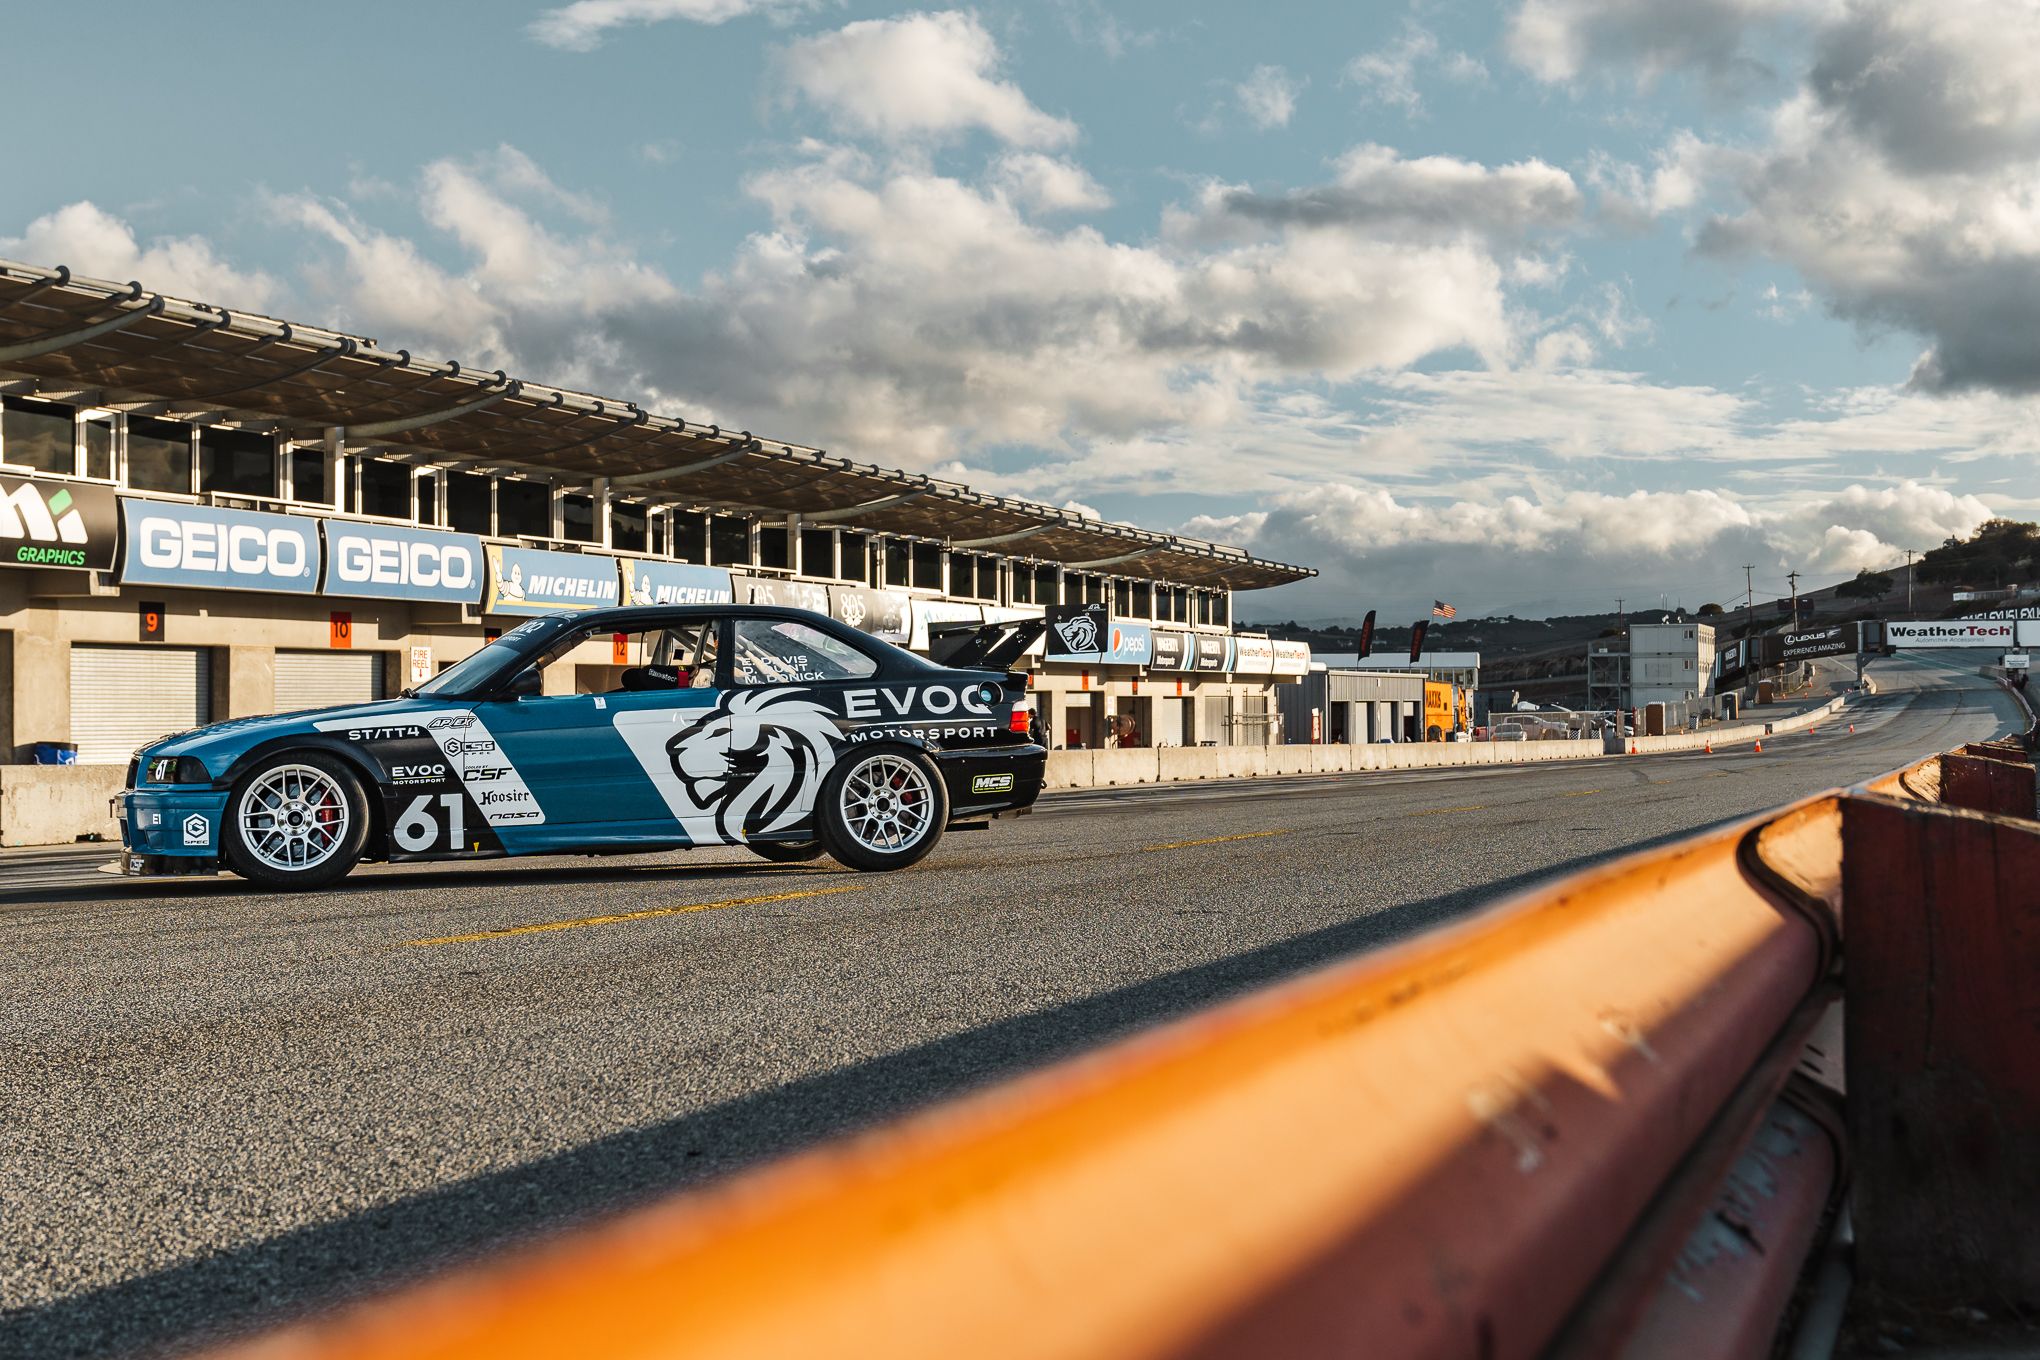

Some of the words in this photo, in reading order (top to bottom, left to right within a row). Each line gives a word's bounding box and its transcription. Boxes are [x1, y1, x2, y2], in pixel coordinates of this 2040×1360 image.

[140, 517, 306, 577] GEICO
[17, 546, 86, 565] GRAPHICS
[338, 536, 472, 589] GEICO
[528, 575, 616, 599] MICHELIN
[656, 585, 730, 603] MICHELIN
[841, 593, 867, 618] 805
[145, 612, 158, 632] 9
[333, 621, 349, 638] 10
[1795, 632, 1826, 642] LEXUS
[1890, 626, 2011, 638] WeatherTech
[615, 641, 625, 656] 12
[1123, 634, 1145, 656] pepsi
[1783, 645, 1817, 657] EXPERIENCE
[1817, 641, 1846, 652] AMAZING
[413, 649, 429, 659] FIRE
[761, 655, 808, 665] DVIS
[412, 659, 430, 669] REEL
[843, 685, 993, 718] EVOQ
[432, 718, 475, 729] APEX
[348, 727, 420, 741] ST/TT4
[851, 727, 998, 743] MOTORSPORT
[155, 759, 168, 781] 61
[392, 764, 446, 777] EVOQ
[463, 767, 513, 782] CSF
[974, 776, 1011, 789] MCS
[479, 790, 529, 805] Hoosier
[393, 793, 464, 852] 61
[130, 859, 145, 871] CSF
